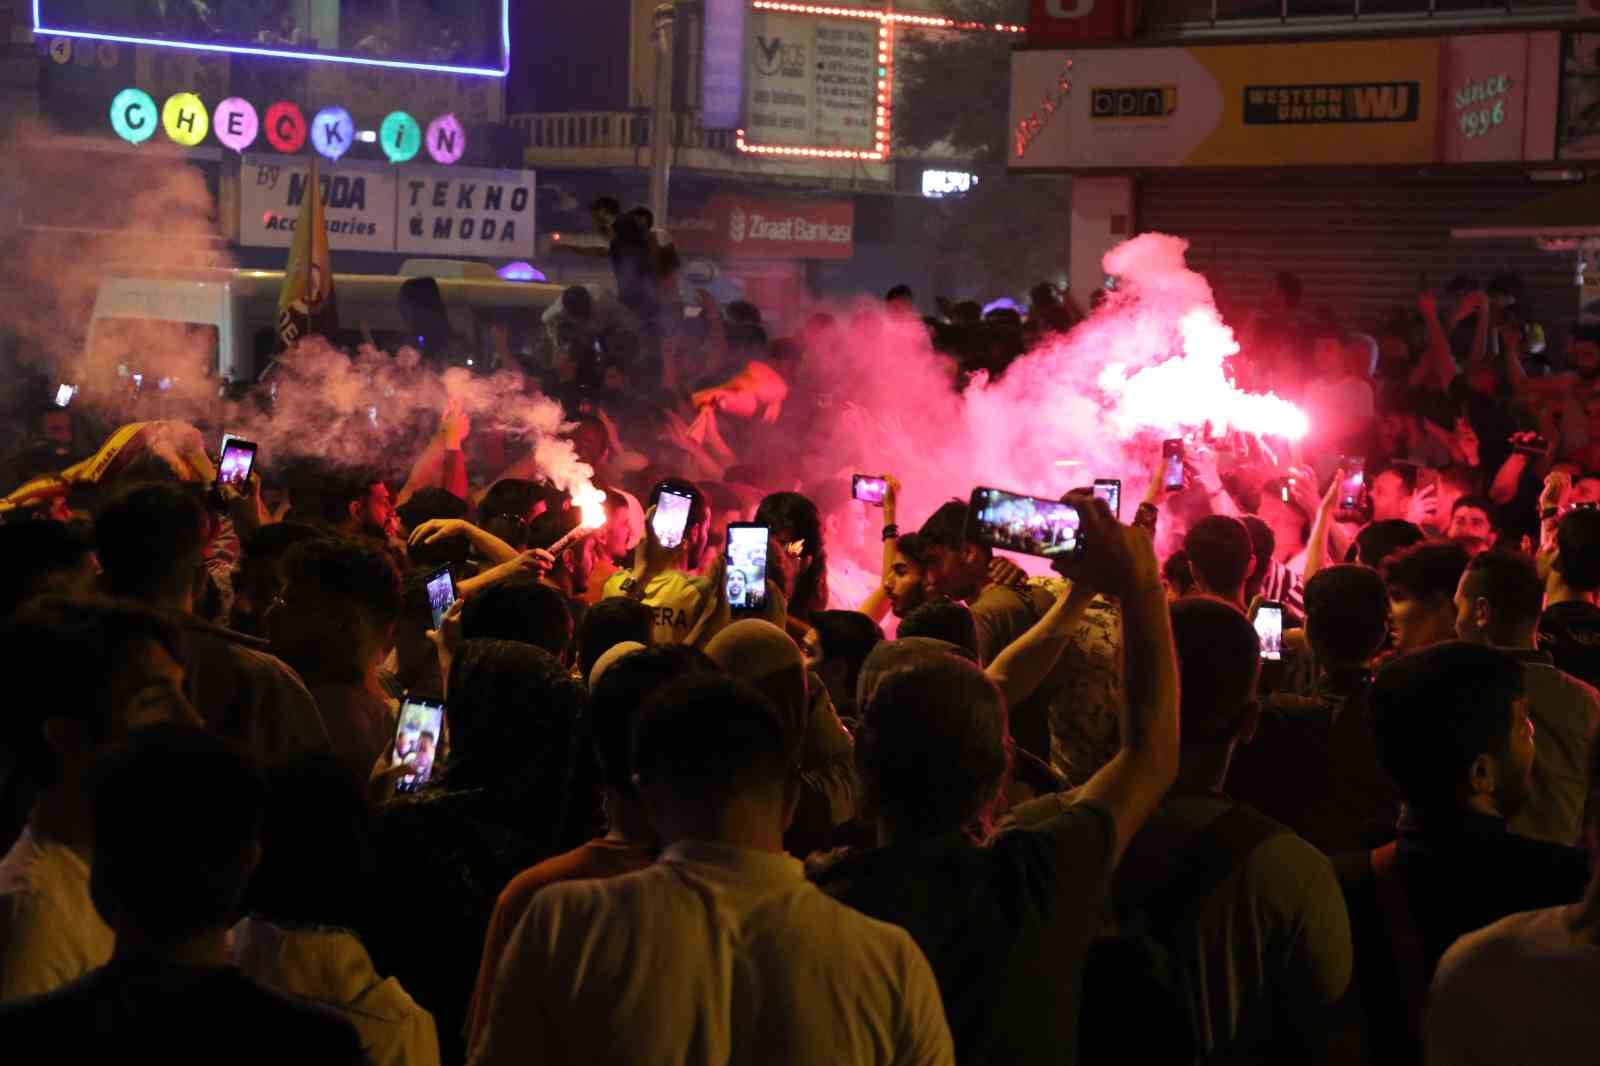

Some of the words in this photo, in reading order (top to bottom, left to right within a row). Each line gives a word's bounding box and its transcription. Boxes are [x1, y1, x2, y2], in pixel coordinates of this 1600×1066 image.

[1249, 88, 1343, 104] WESTERN
[1278, 103, 1343, 121] UNION
[408, 181, 528, 213] TEKNO
[432, 217, 516, 243] MODA
[749, 212, 793, 241] Ziraat
